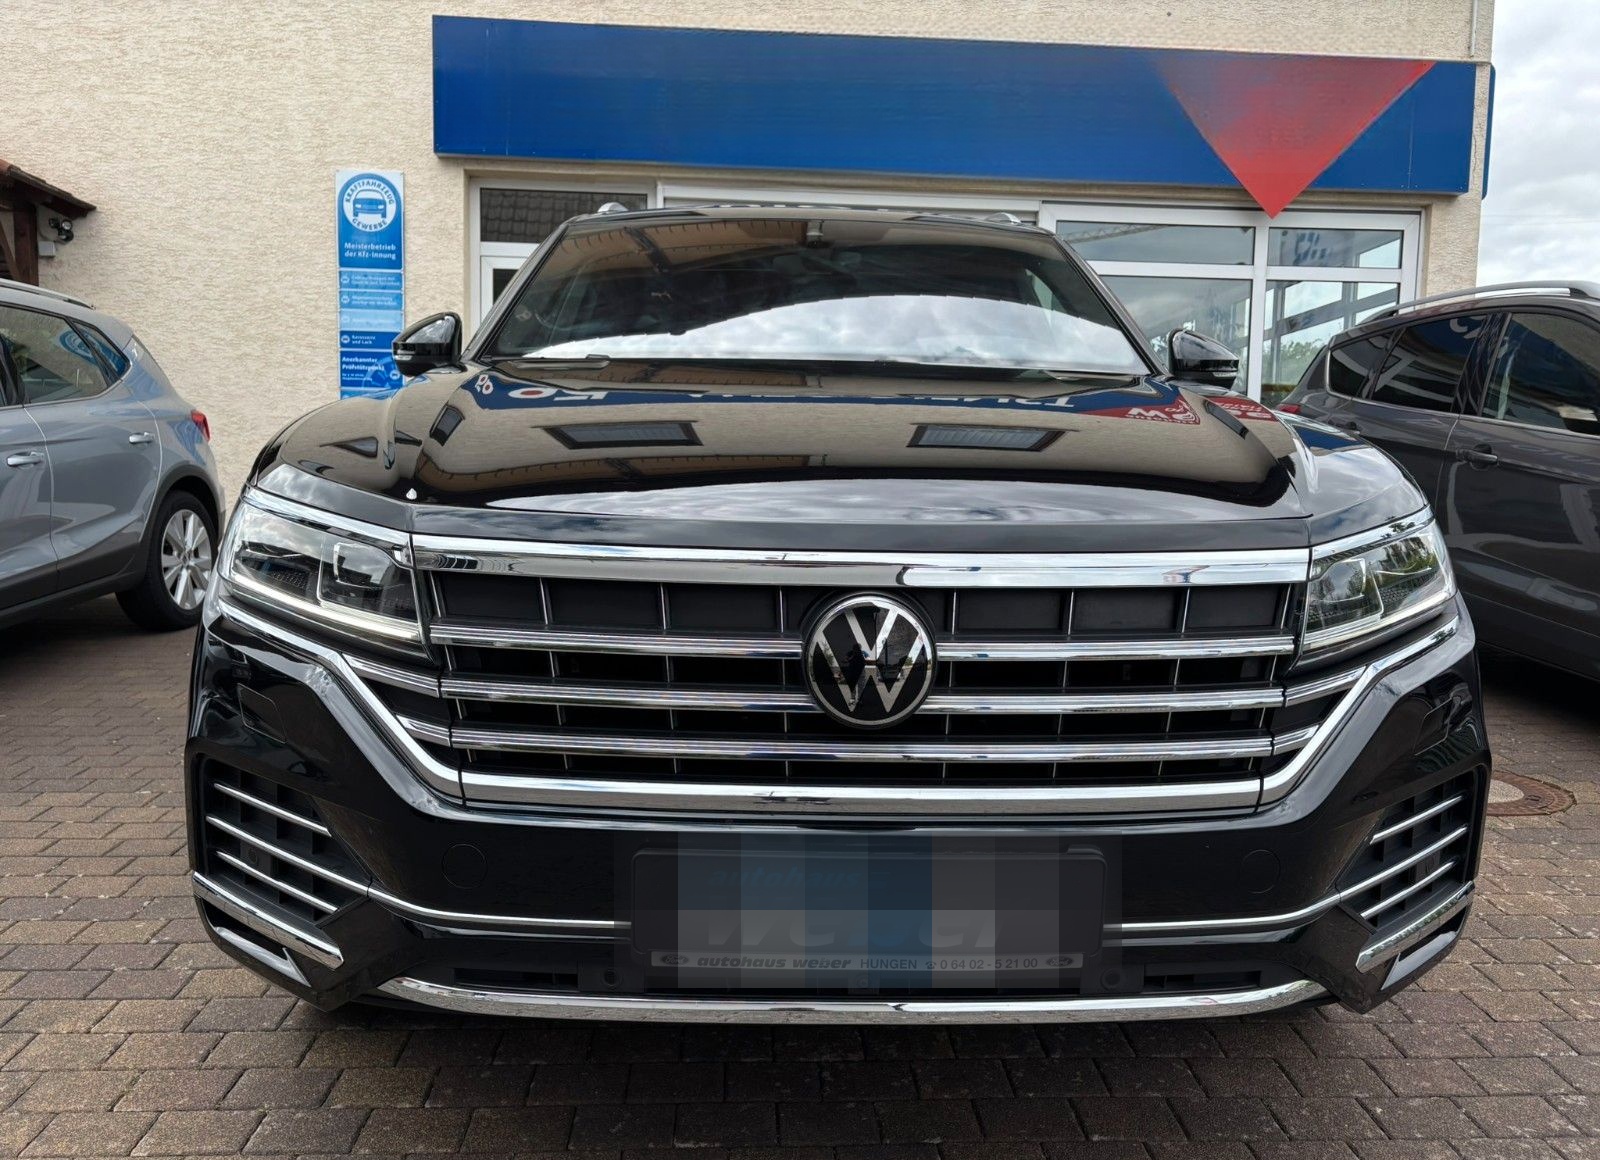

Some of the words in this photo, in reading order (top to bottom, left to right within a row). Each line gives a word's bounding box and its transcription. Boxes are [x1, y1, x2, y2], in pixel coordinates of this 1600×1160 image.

[353, 218, 387, 230] GEWERBE
[344, 242, 396, 250] Meisterbetrieb
[357, 251, 396, 260] Kfz-Innung
[697, 956, 786, 968] autohaus
[793, 957, 851, 969] weber
[860, 958, 917, 969] HUNGEN
[951, 959, 965, 969] 64
[969, 959, 984, 969] 02
[1005, 959, 1019, 969] 21
[1023, 958, 1038, 968] 00
